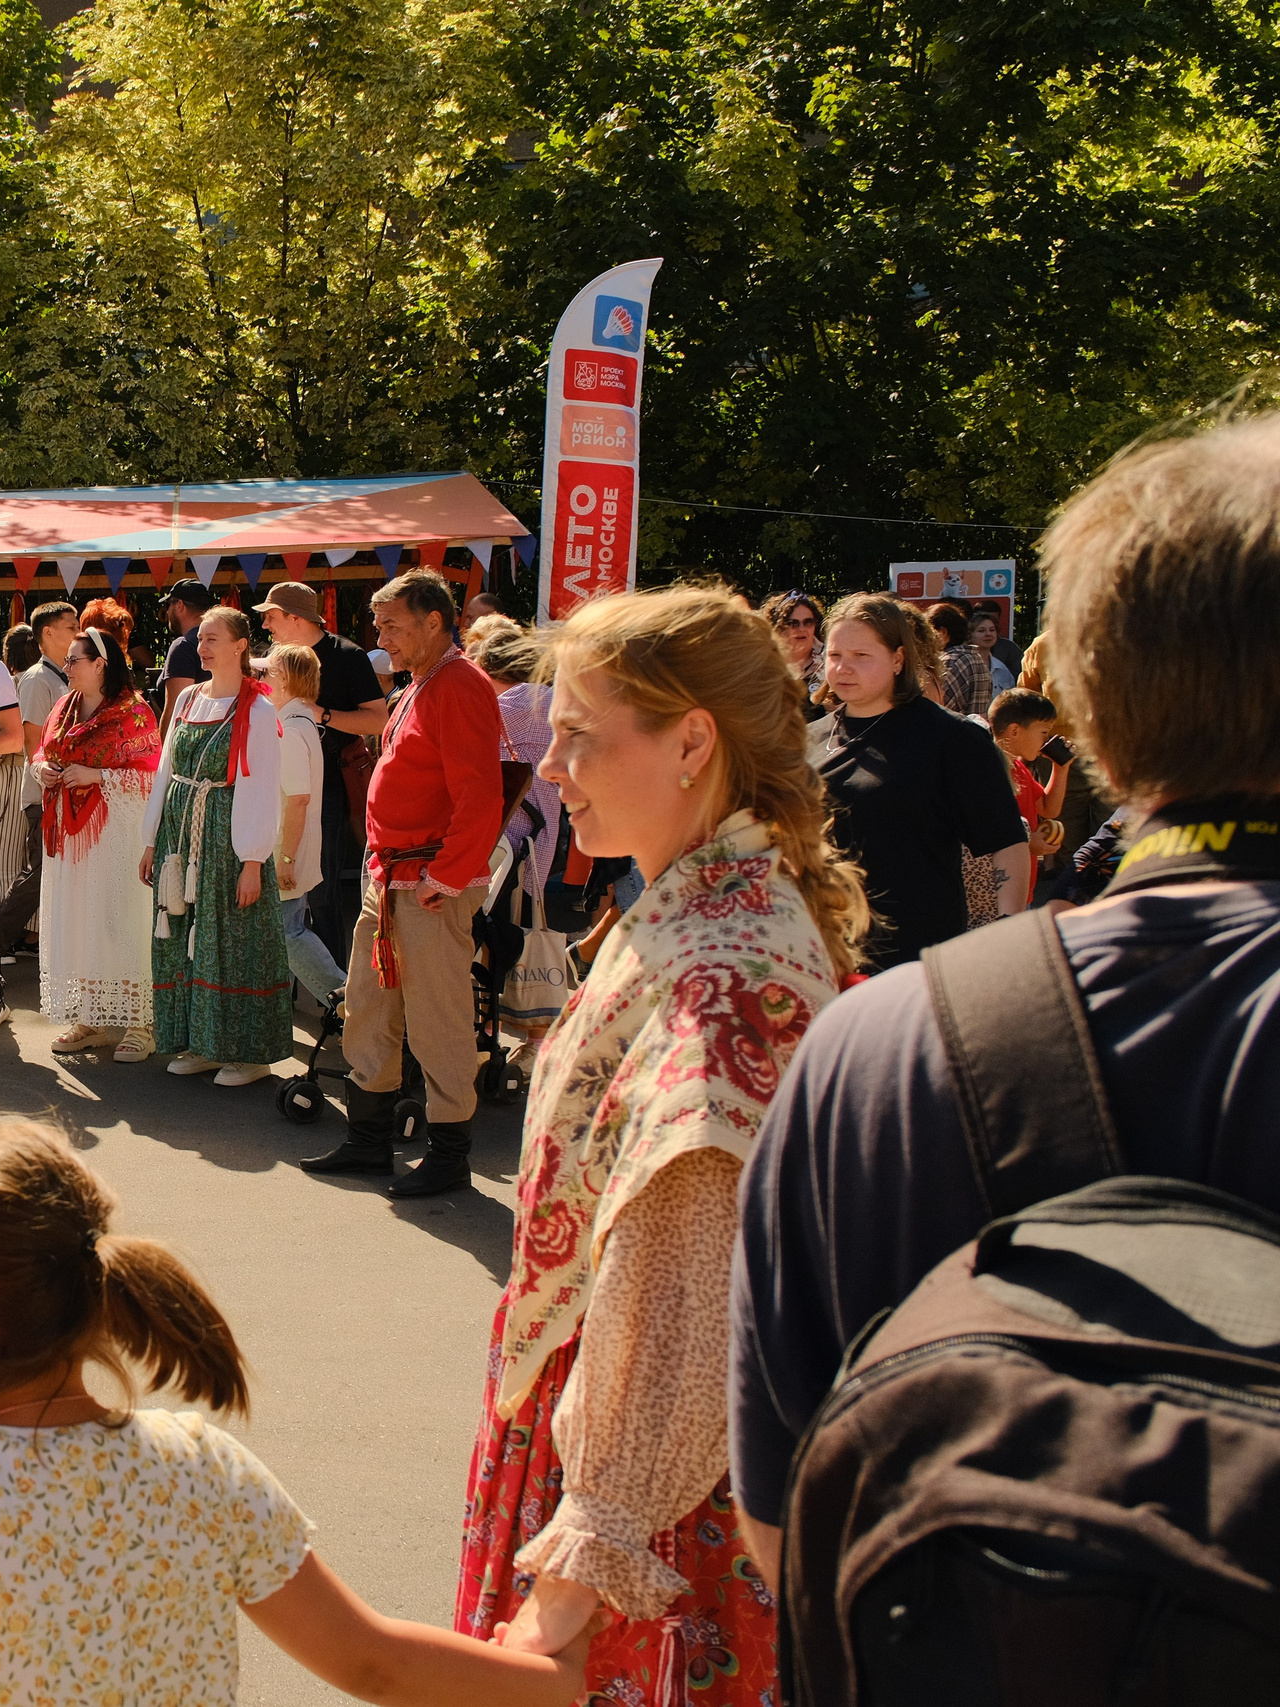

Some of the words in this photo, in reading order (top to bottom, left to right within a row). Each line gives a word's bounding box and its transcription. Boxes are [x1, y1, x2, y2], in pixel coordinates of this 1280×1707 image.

[601, 366, 624, 376] ПРОЕКТ
[600, 373, 620, 381] МЭРА
[600, 380, 626, 390] МОСКВЫ
[597, 487, 619, 581] МОСКВЕ
[563, 484, 597, 599] ЛЕТО
